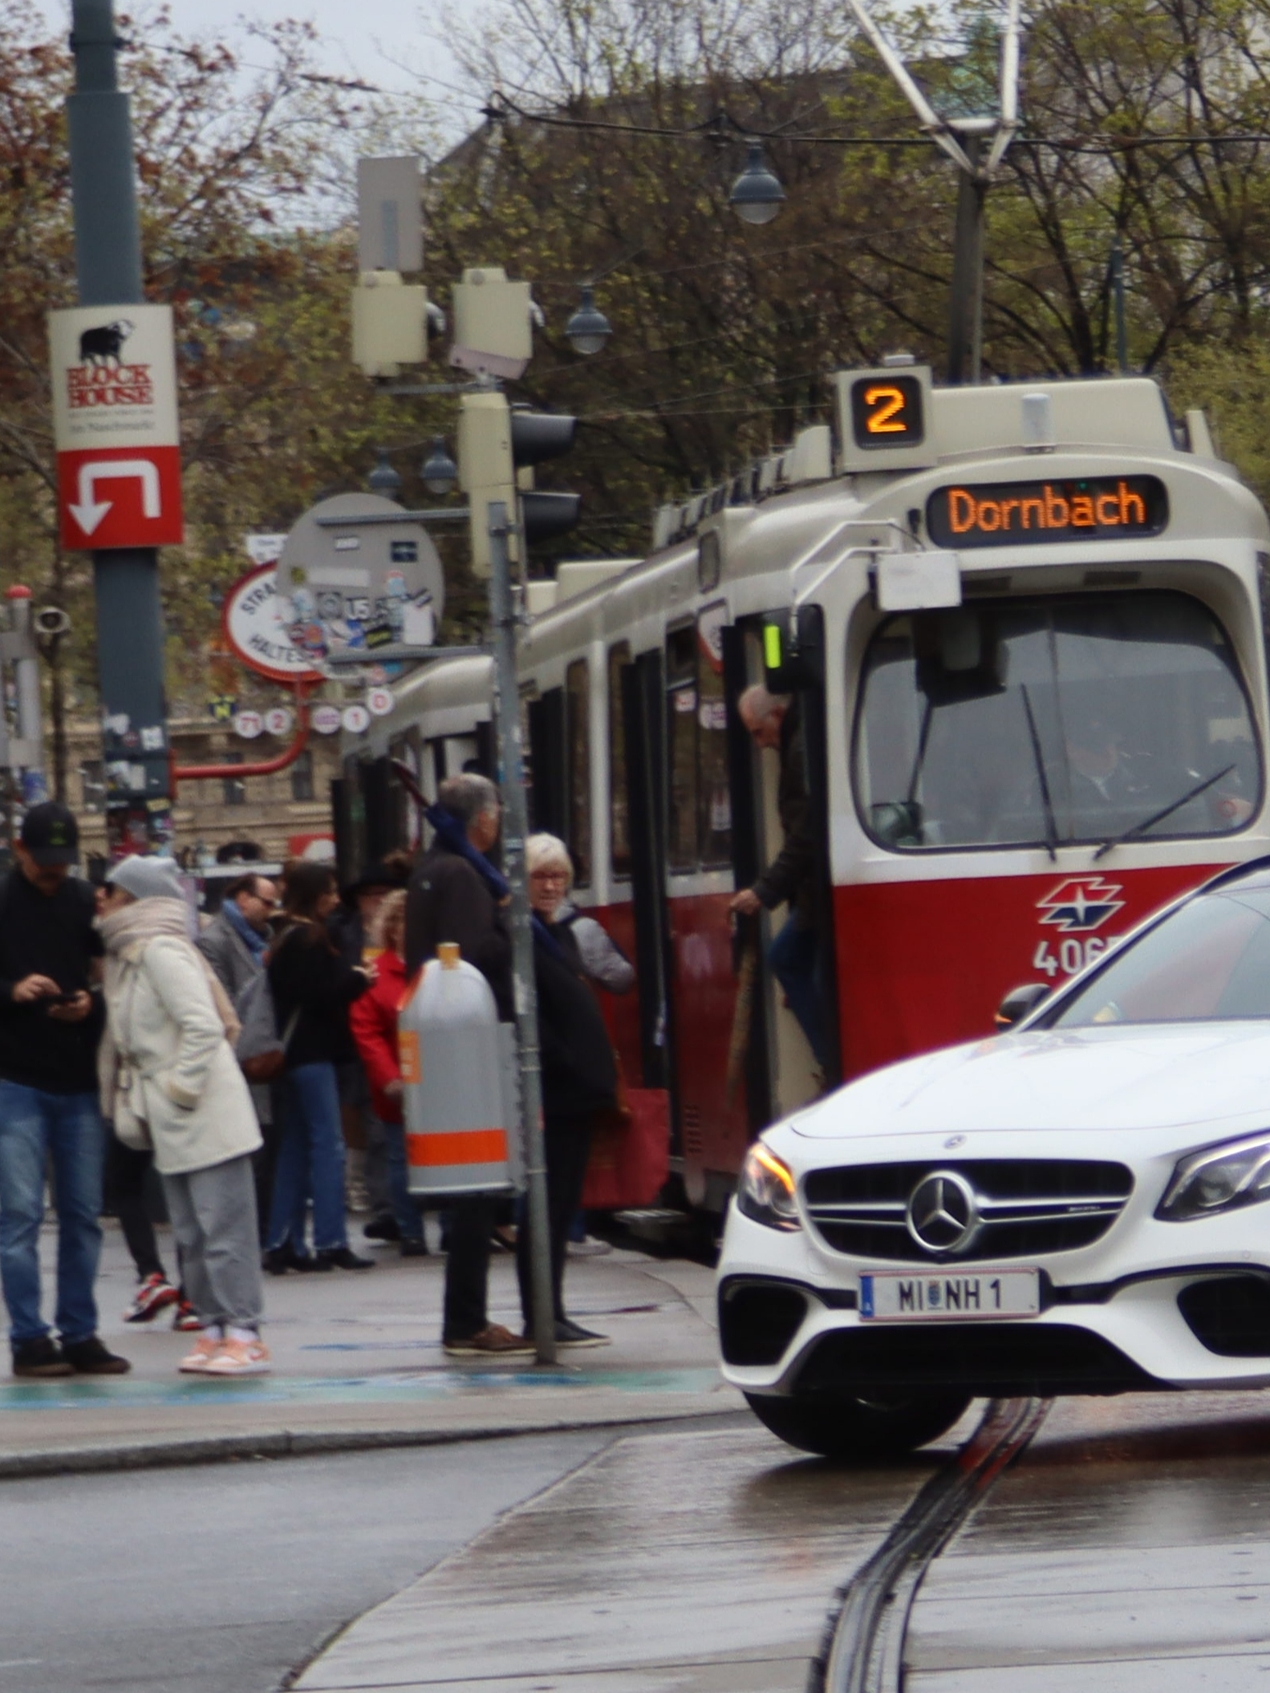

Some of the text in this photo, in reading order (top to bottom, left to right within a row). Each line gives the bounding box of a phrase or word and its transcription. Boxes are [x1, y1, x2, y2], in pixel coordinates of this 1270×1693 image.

[66, 364, 152, 387] BLOCK
[68, 385, 154, 408] HOUSE
[865, 385, 906, 433] 2
[949, 481, 1147, 533] Dornbach
[1033, 937, 1122, 976] 406
[898, 1276, 1002, 1312] MI NH 1
